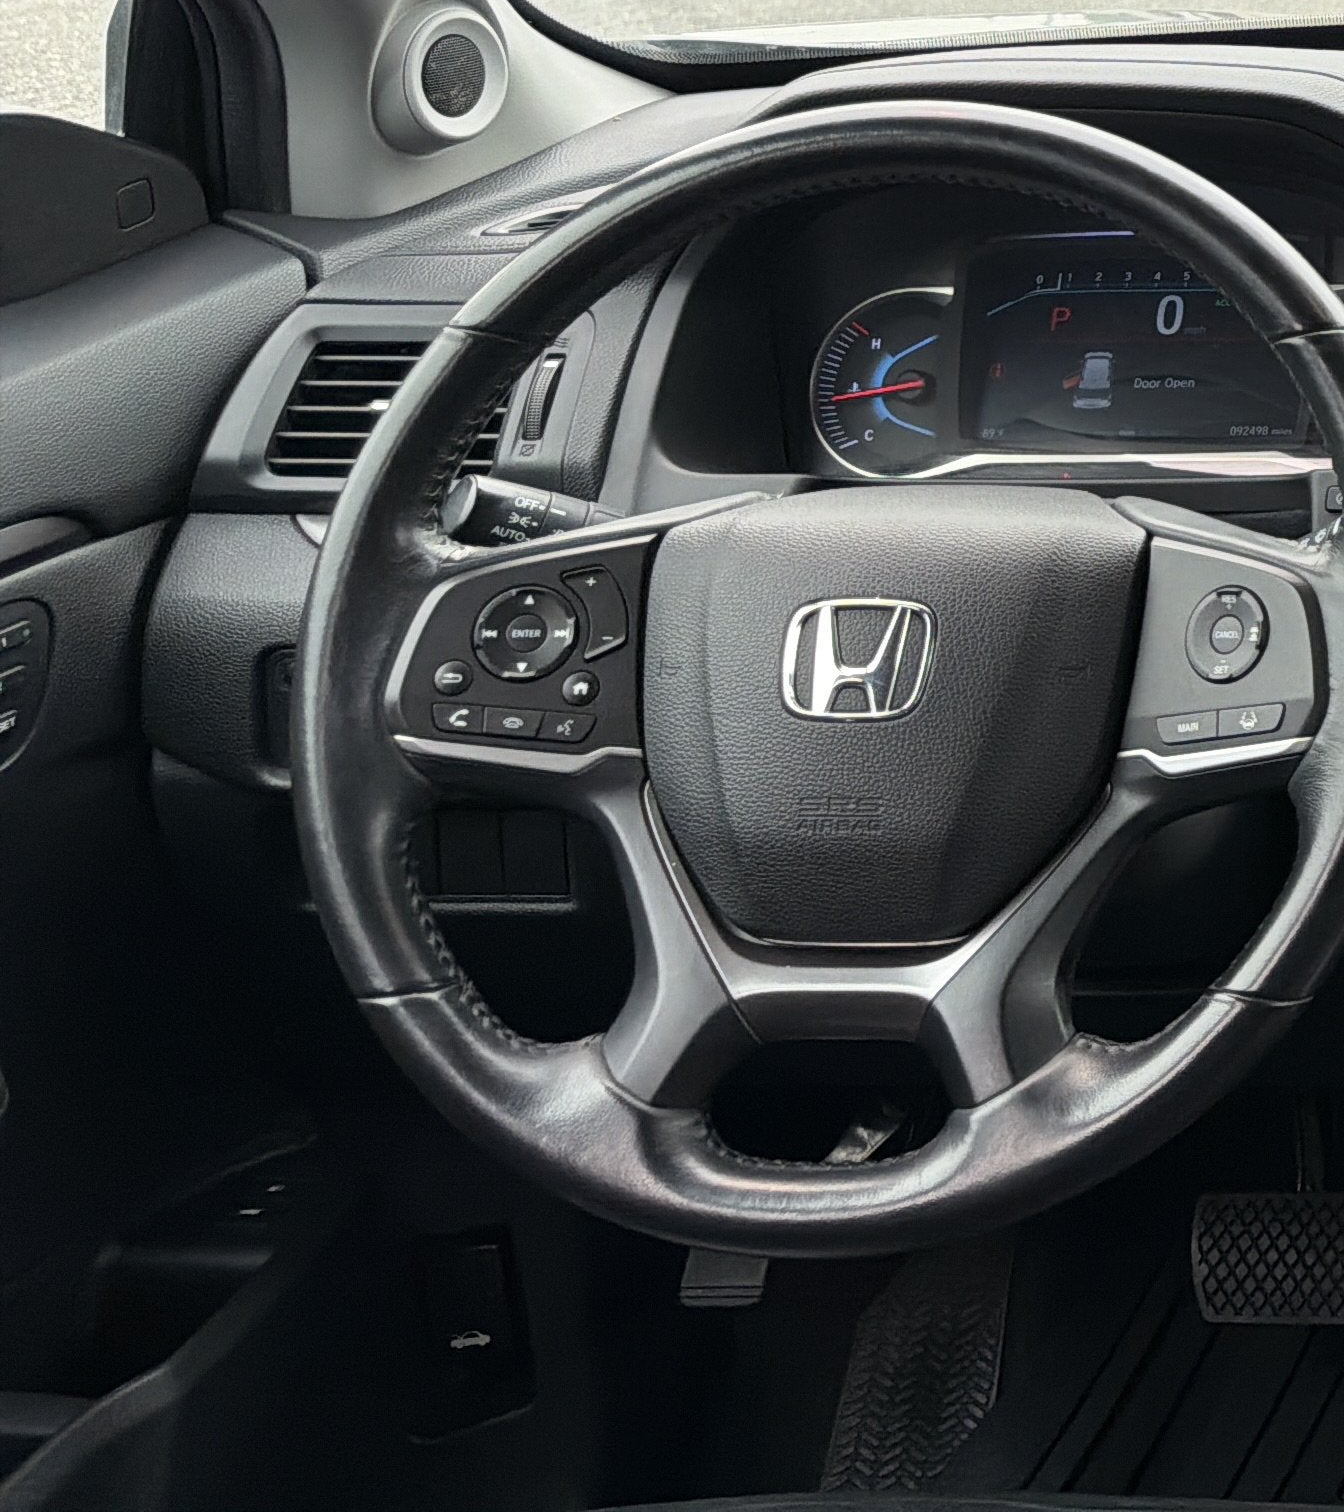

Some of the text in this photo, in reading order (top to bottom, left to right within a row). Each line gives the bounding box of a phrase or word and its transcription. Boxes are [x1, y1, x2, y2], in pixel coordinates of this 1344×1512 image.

[1036, 275, 1044, 285] 0
[1095, 272, 1103, 282] 2
[1125, 272, 1133, 281] 3
[1153, 272, 1161, 281] 4
[1183, 272, 1191, 281] 5
[1051, 307, 1072, 331] P
[1156, 294, 1184, 336] 0
[871, 338, 882, 350] H
[1133, 378, 1196, 391] Door Open
[864, 429, 874, 441] C
[1229, 426, 1269, 436] 092498
[514, 496, 540, 511] OFF
[490, 525, 526, 542] AUTO
[511, 628, 542, 639] ENTER
[1213, 665, 1229, 675] SET
